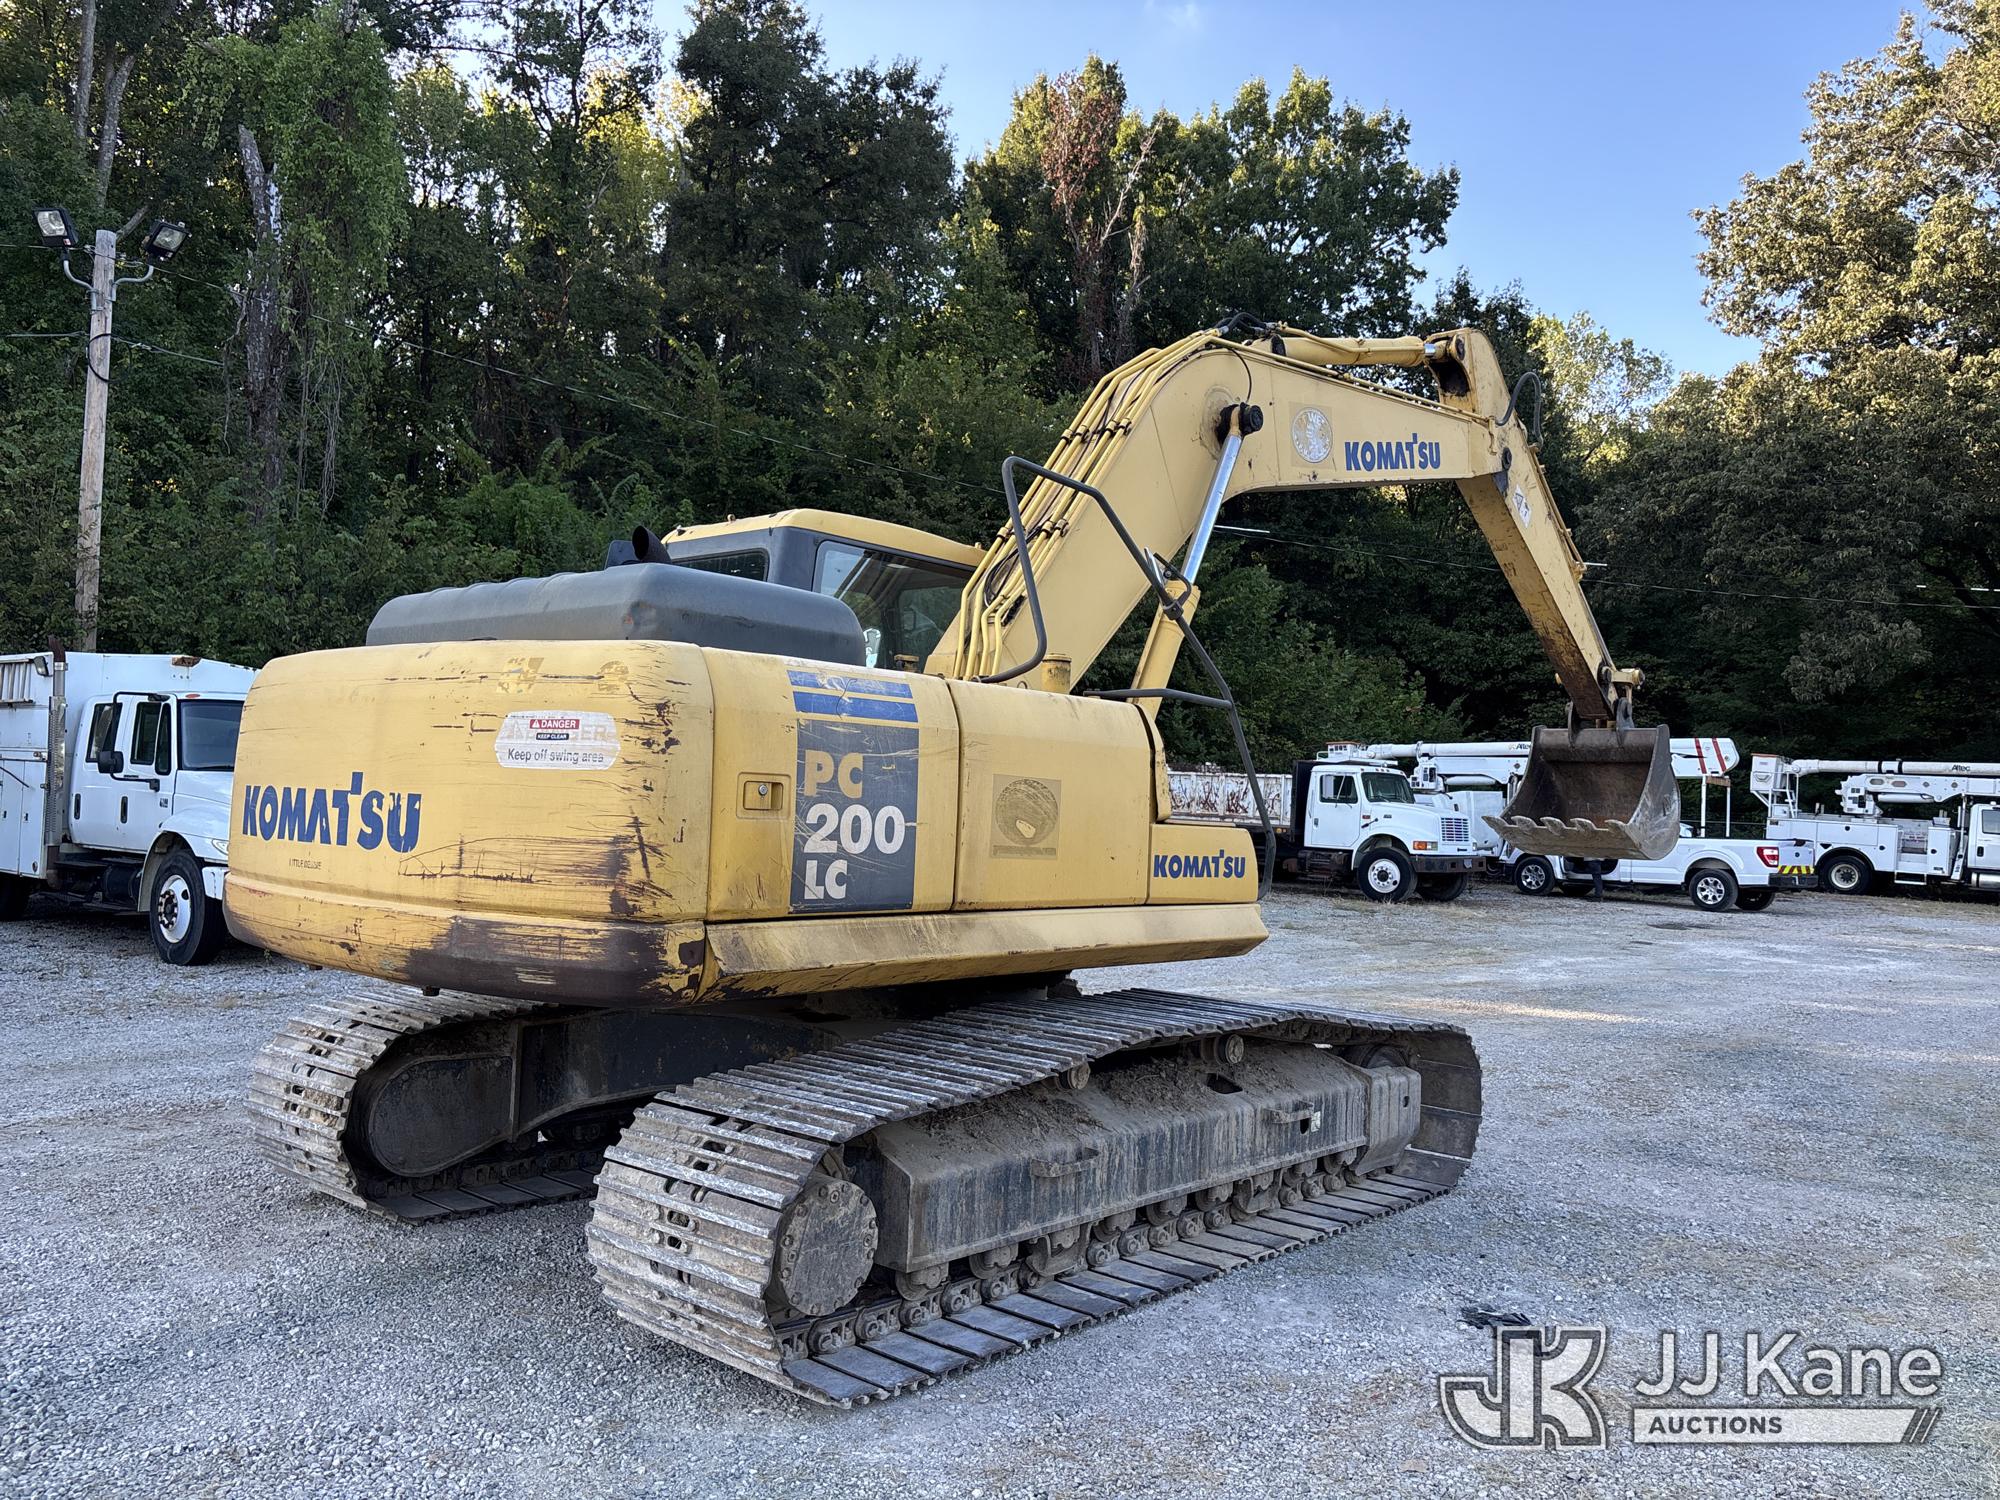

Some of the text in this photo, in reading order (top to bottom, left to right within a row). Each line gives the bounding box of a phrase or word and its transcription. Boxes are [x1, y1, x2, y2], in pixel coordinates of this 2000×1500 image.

[1344, 433, 1441, 472] KOMATSU
[540, 719, 577, 729] DANGER
[508, 748, 604, 765] Keep off swing area
[803, 750, 864, 799] PC
[242, 771, 422, 853] KOMATSU
[803, 803, 906, 855] 200
[803, 859, 848, 900] LC
[1153, 849, 1246, 878] KOMATSU
